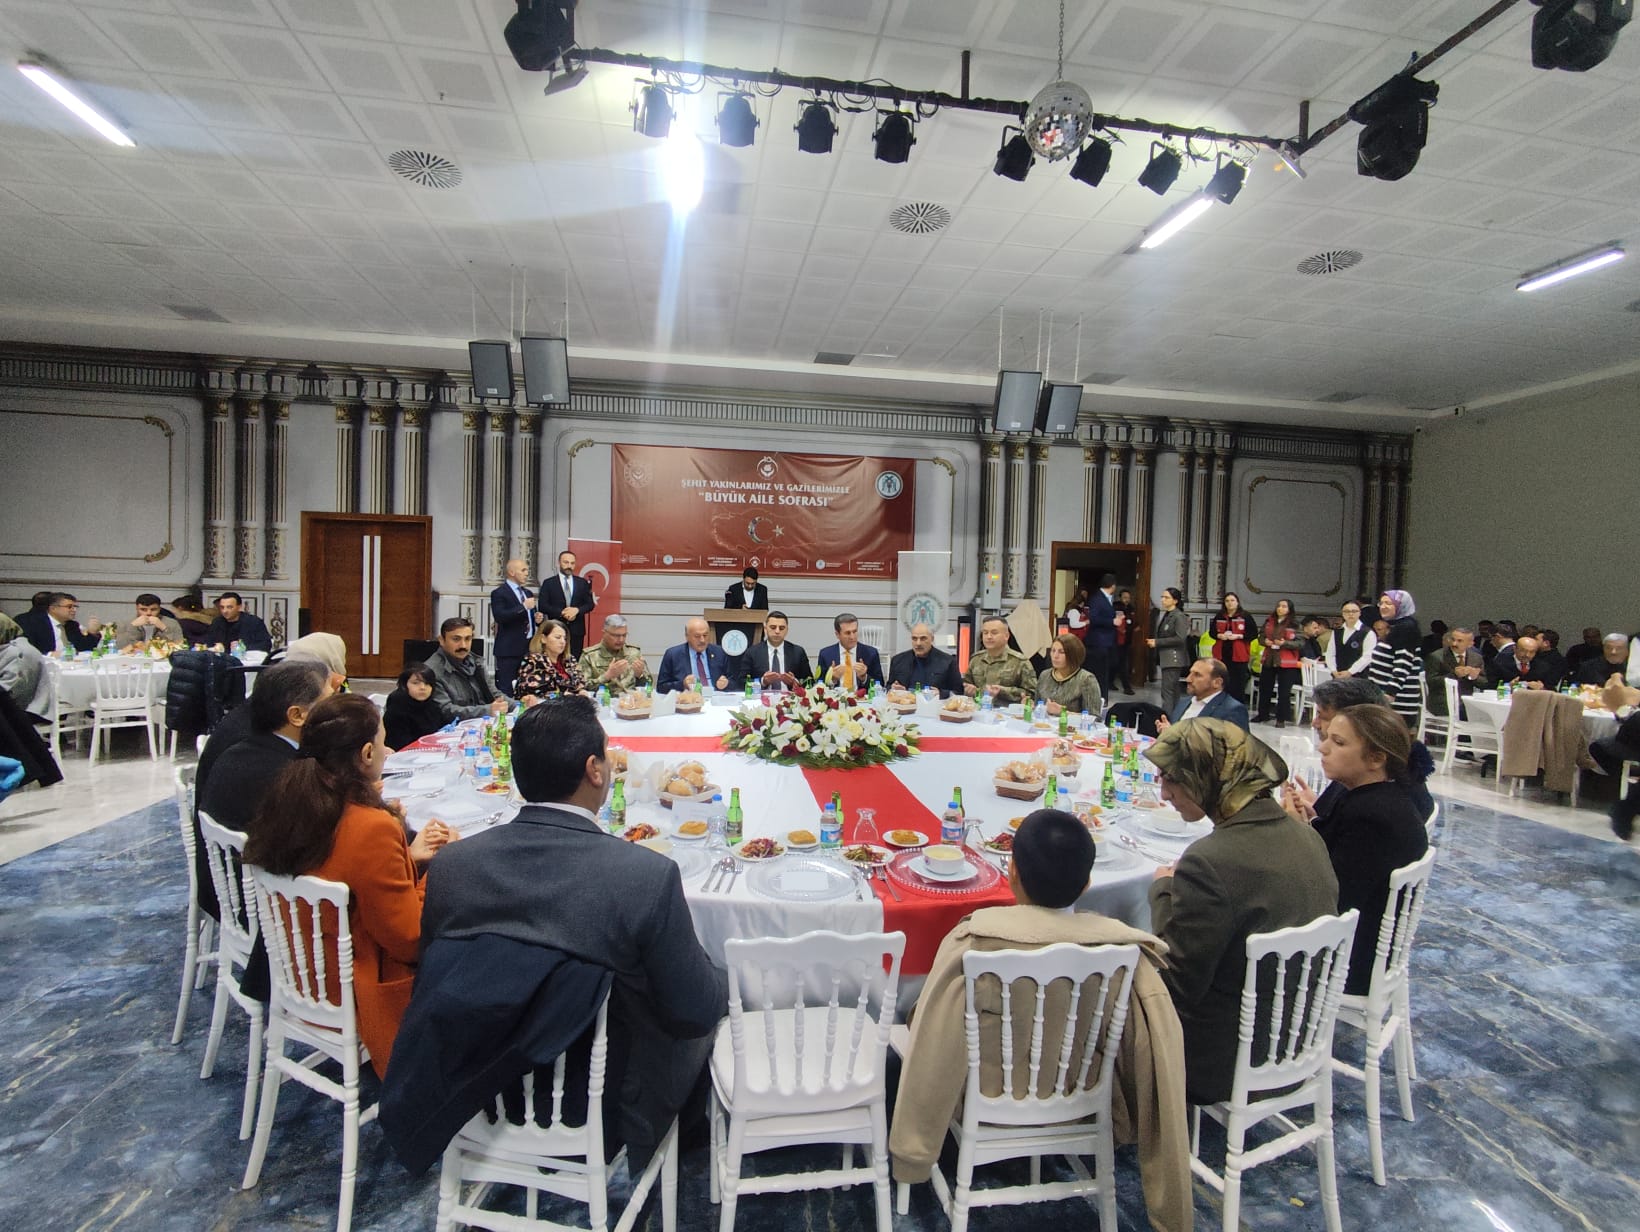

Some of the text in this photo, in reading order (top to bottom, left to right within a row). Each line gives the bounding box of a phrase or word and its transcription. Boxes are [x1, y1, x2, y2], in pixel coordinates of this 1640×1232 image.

[709, 480, 771, 491] YAKINLARIMIZ
[774, 483, 785, 491] VE
[698, 490, 746, 504] "BÜYÜK
[748, 491, 774, 505] AİLE
